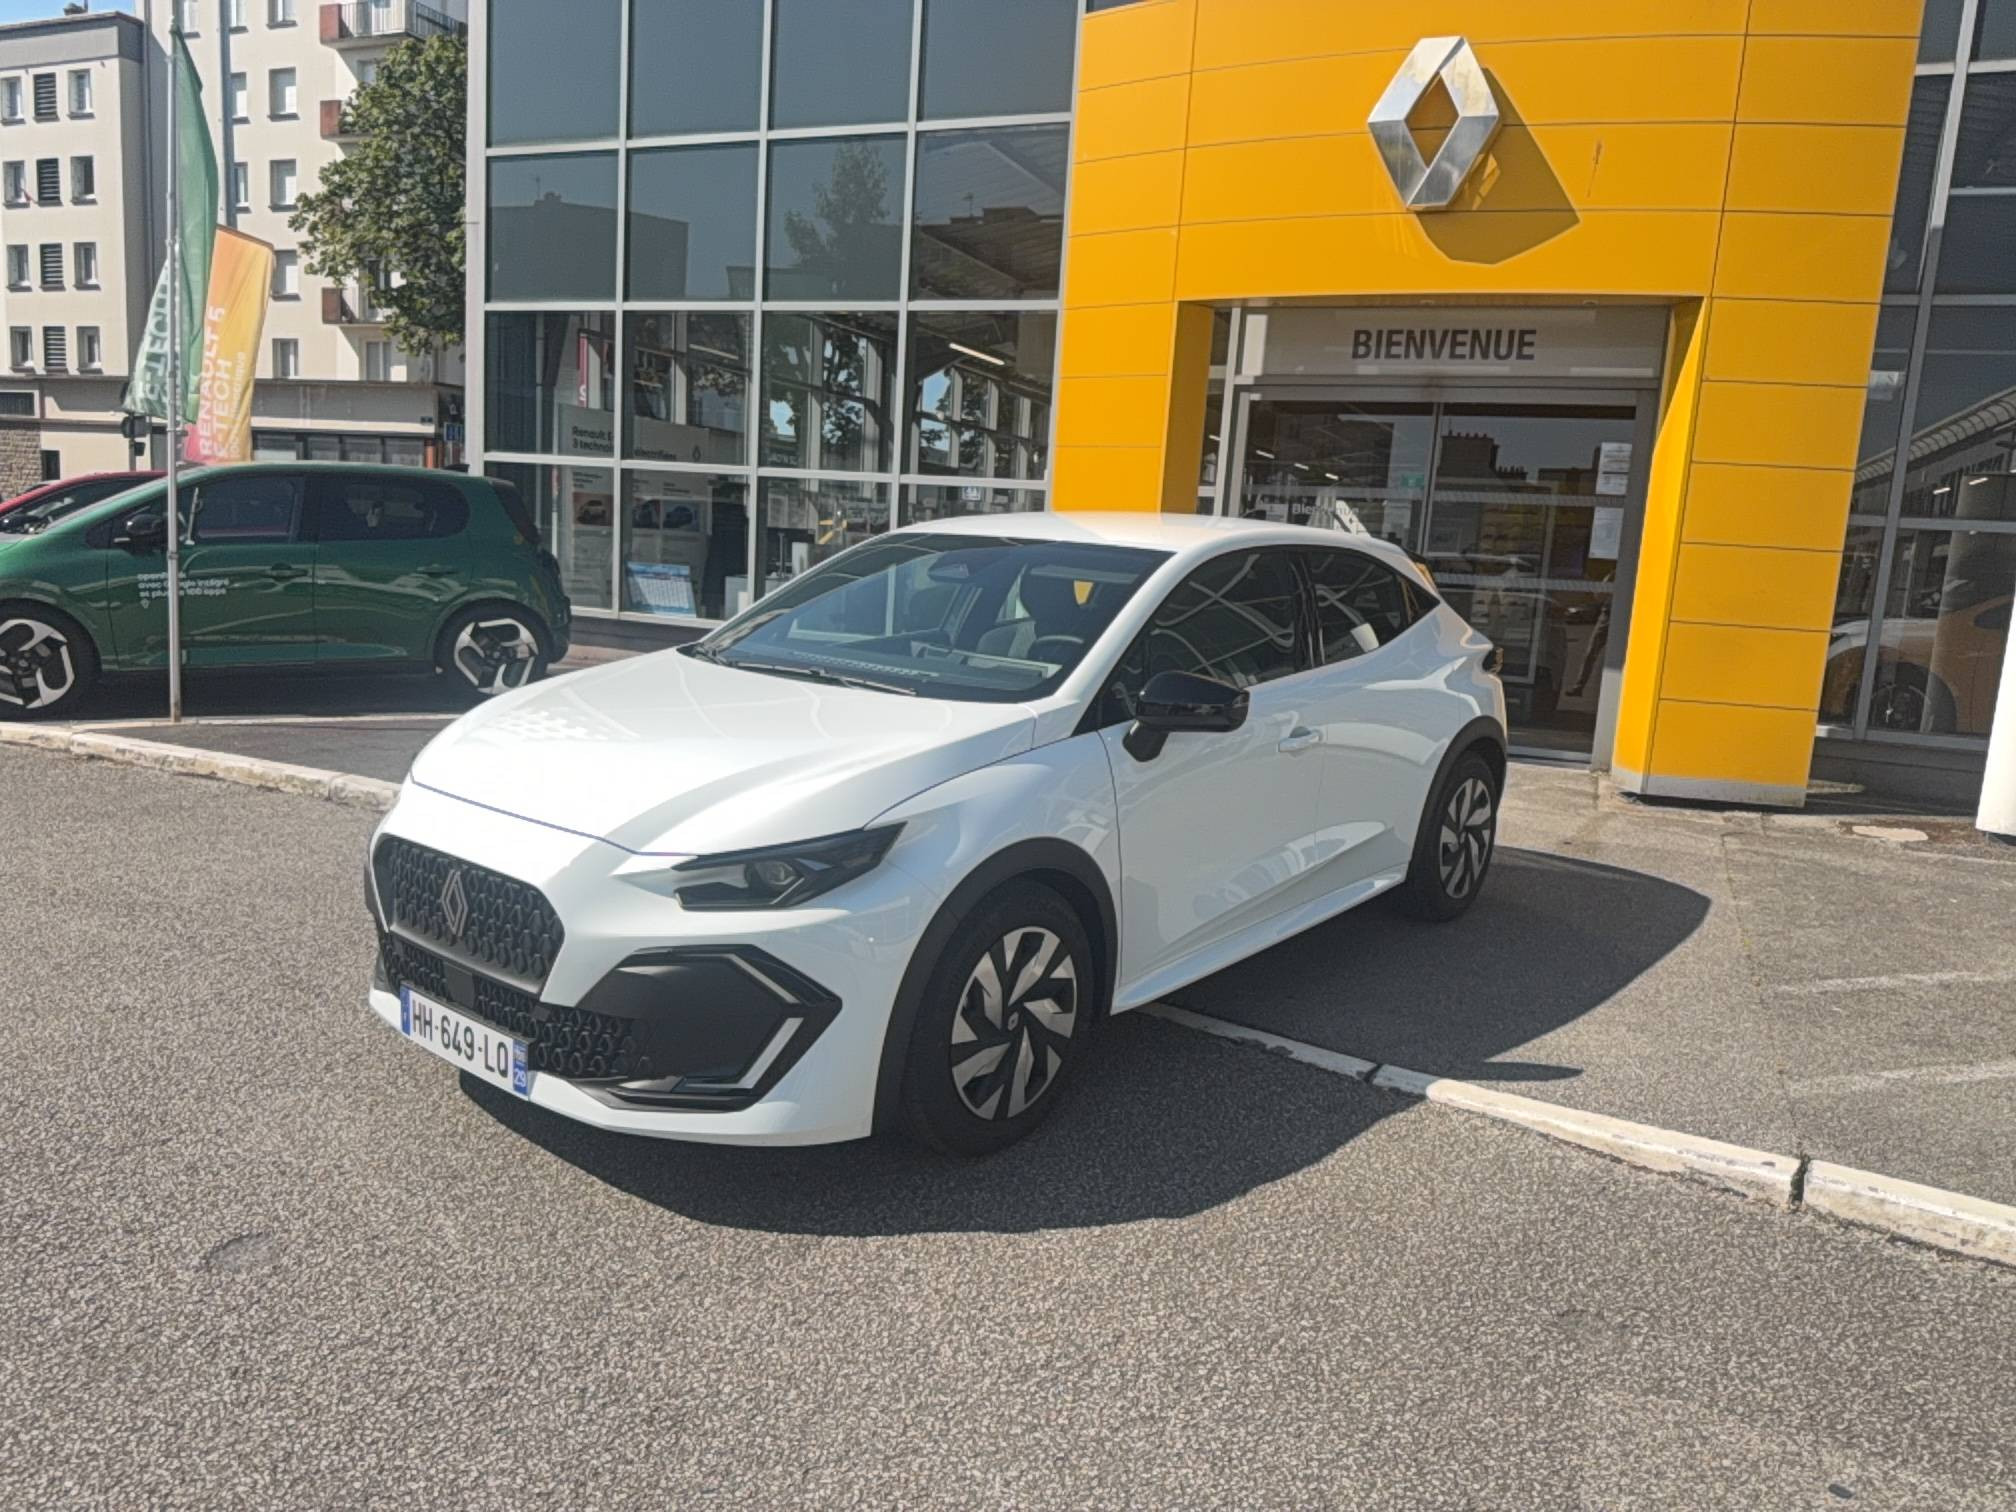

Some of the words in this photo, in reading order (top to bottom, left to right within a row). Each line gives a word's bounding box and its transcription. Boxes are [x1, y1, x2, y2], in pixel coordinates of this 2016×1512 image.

[208, 305, 225, 321] 5
[1352, 329, 1537, 360] BIENVENUE
[198, 326, 221, 455] RENAULT
[514, 1067, 526, 1087] 29
